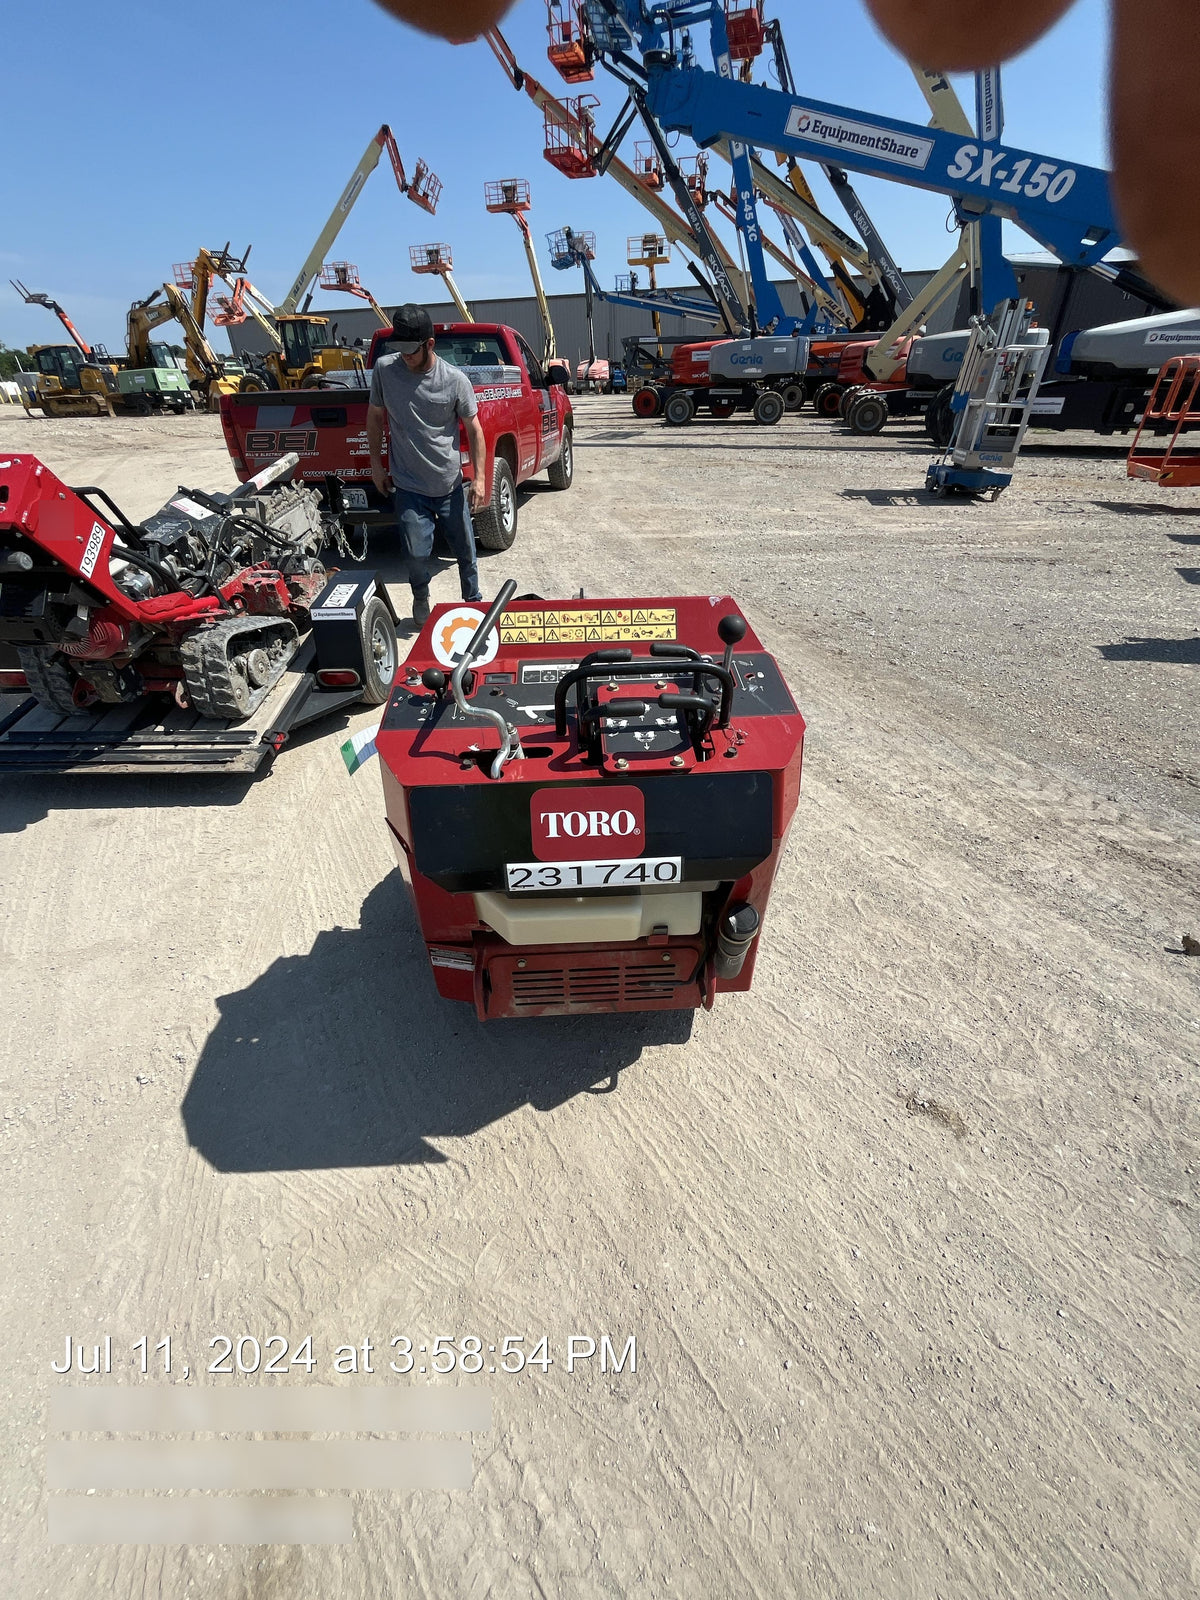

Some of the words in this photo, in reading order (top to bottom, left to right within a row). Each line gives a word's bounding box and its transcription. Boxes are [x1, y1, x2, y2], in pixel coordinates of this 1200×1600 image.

[811, 119, 919, 159] EquipmentShare
[947, 145, 1077, 203] SX-150
[741, 190, 755, 220] S-45
[746, 224, 758, 242] XC
[708, 253, 732, 301] SKYJACK
[880, 257, 902, 294] SKYJACK
[730, 353, 764, 365] Genie
[541, 411, 559, 436] BEI
[245, 430, 319, 452] BEI
[978, 453, 1003, 462] Genie
[80, 525, 104, 574] 193989
[509, 861, 678, 888] 231740
